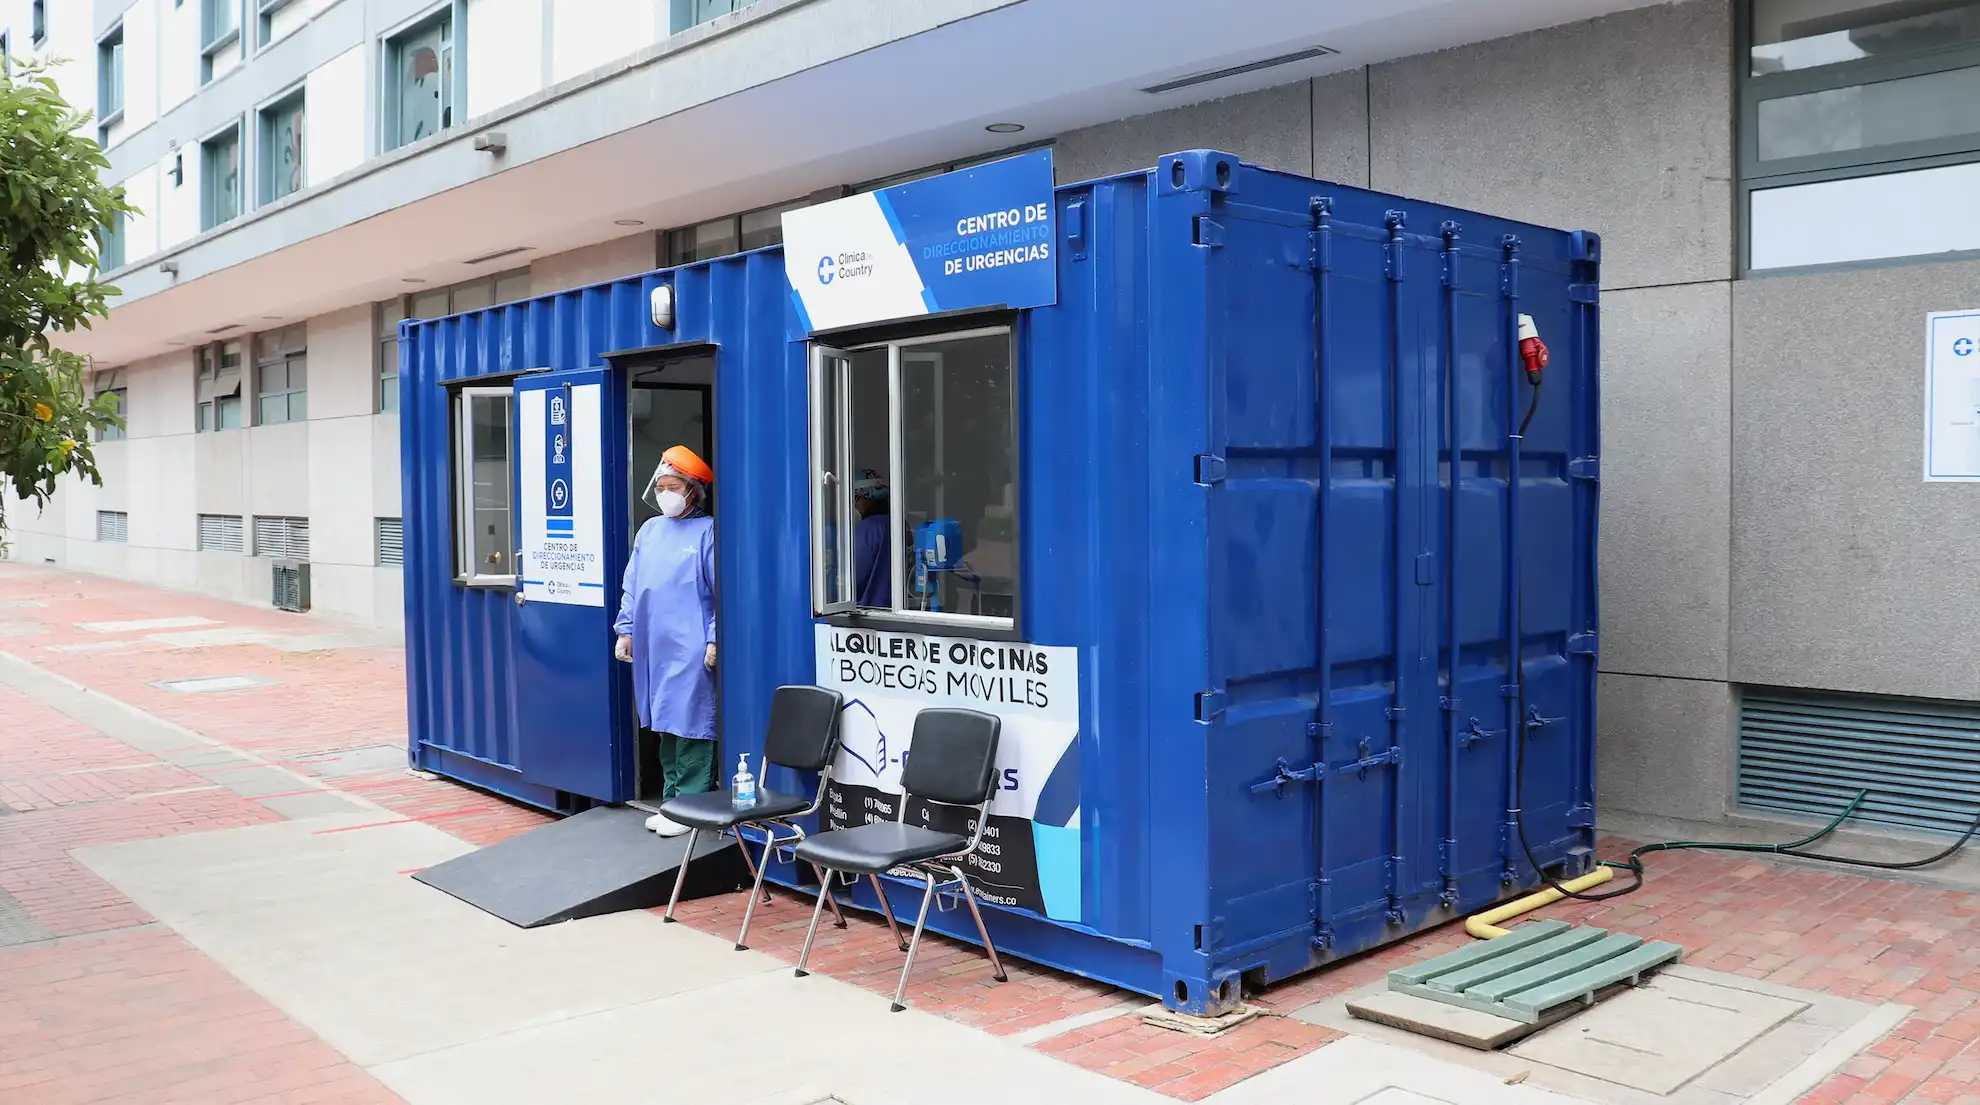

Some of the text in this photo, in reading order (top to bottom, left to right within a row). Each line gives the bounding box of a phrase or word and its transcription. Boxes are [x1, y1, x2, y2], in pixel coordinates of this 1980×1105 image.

[957, 202, 1047, 236] CENTRO DE
[922, 224, 1050, 260] DIRECCIONAMIENTO
[944, 242, 1050, 276] DE URGENCIAS
[838, 264, 873, 279] Country
[532, 550, 595, 563] DIRECCIONAMIENTO
[543, 542, 578, 552] CENTRO DE
[540, 560, 585, 572] DE URGENCIAS
[830, 632, 919, 660] LQULER
[948, 643, 1048, 675] OFCINAS
[947, 671, 1049, 709] MOVILES
